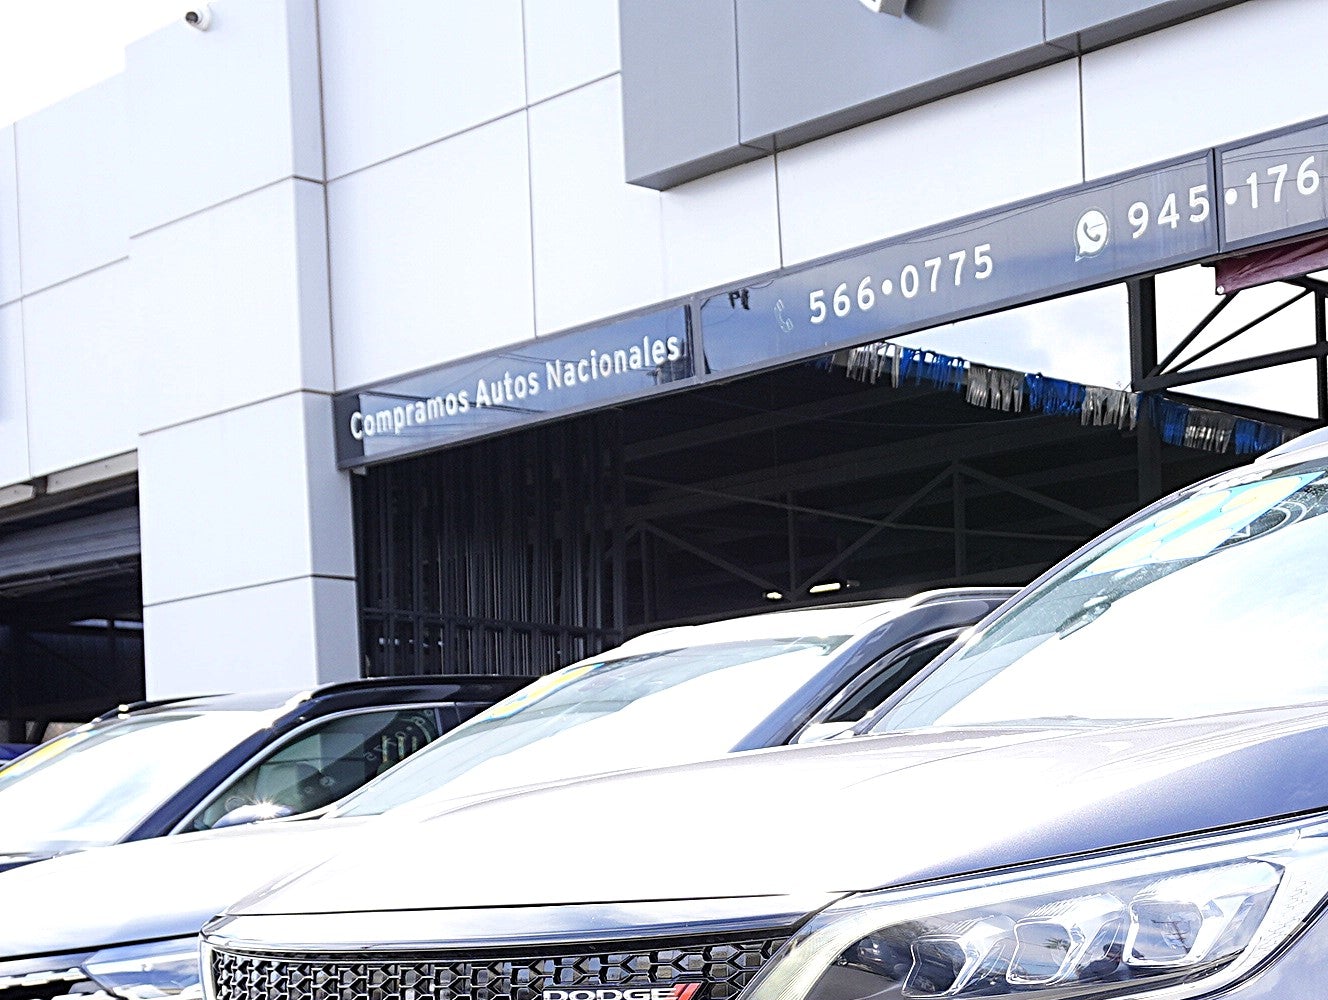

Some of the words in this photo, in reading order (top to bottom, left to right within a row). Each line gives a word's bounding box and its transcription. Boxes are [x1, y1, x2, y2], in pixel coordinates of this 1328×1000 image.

[350, 389, 470, 440] Compramos
[476, 370, 540, 408] Autos
[545, 335, 681, 391] Nacionales
